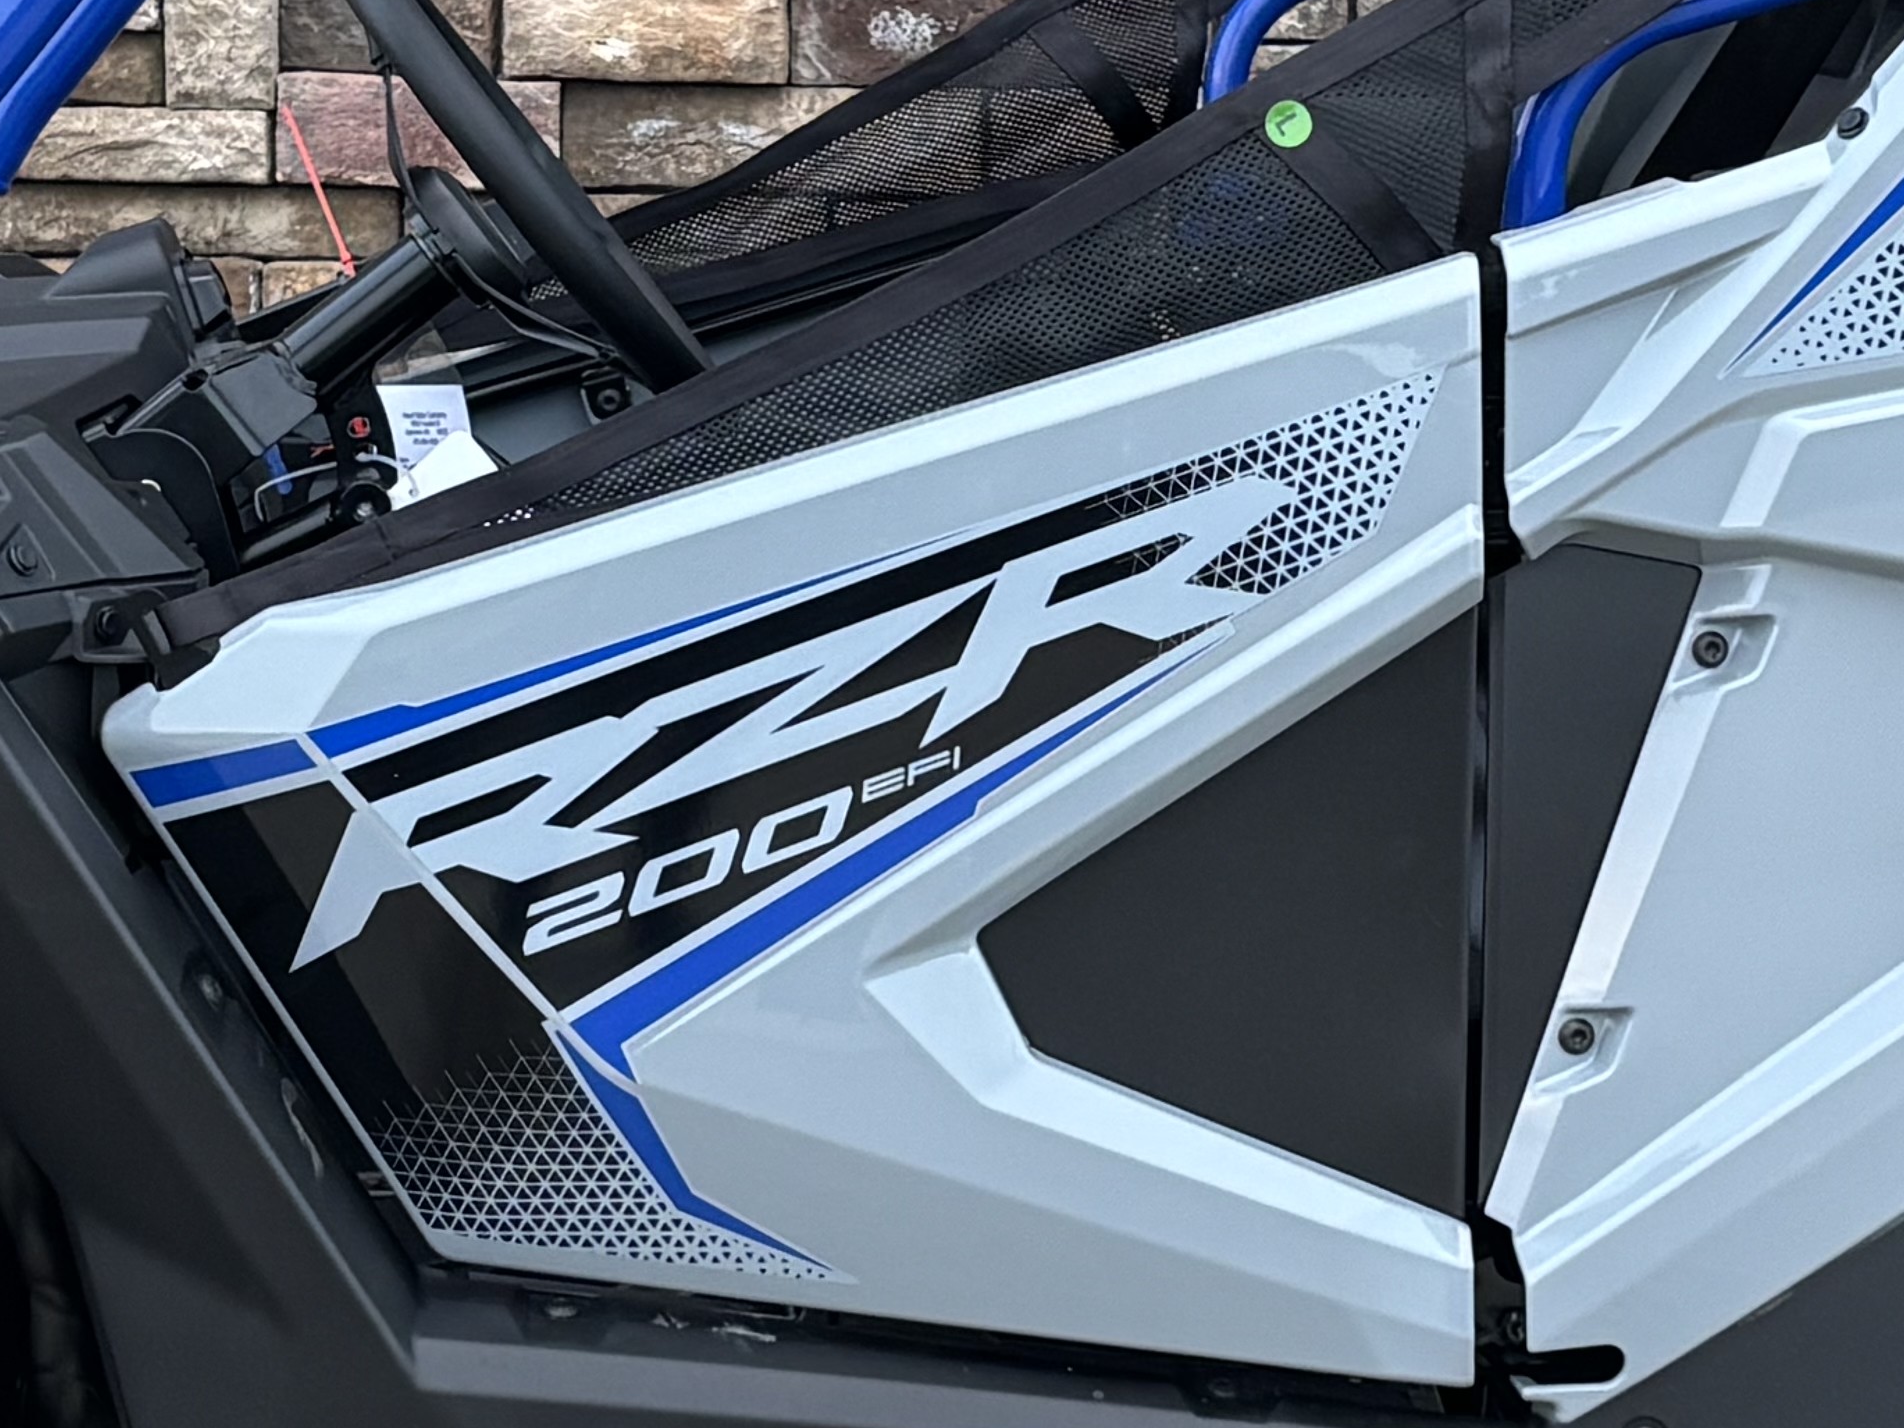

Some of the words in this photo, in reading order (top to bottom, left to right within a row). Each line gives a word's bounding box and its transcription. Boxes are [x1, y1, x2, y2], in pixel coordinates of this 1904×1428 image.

[289, 472, 1297, 973] RZR
[521, 780, 857, 957] 200
[860, 744, 965, 803] EFI
